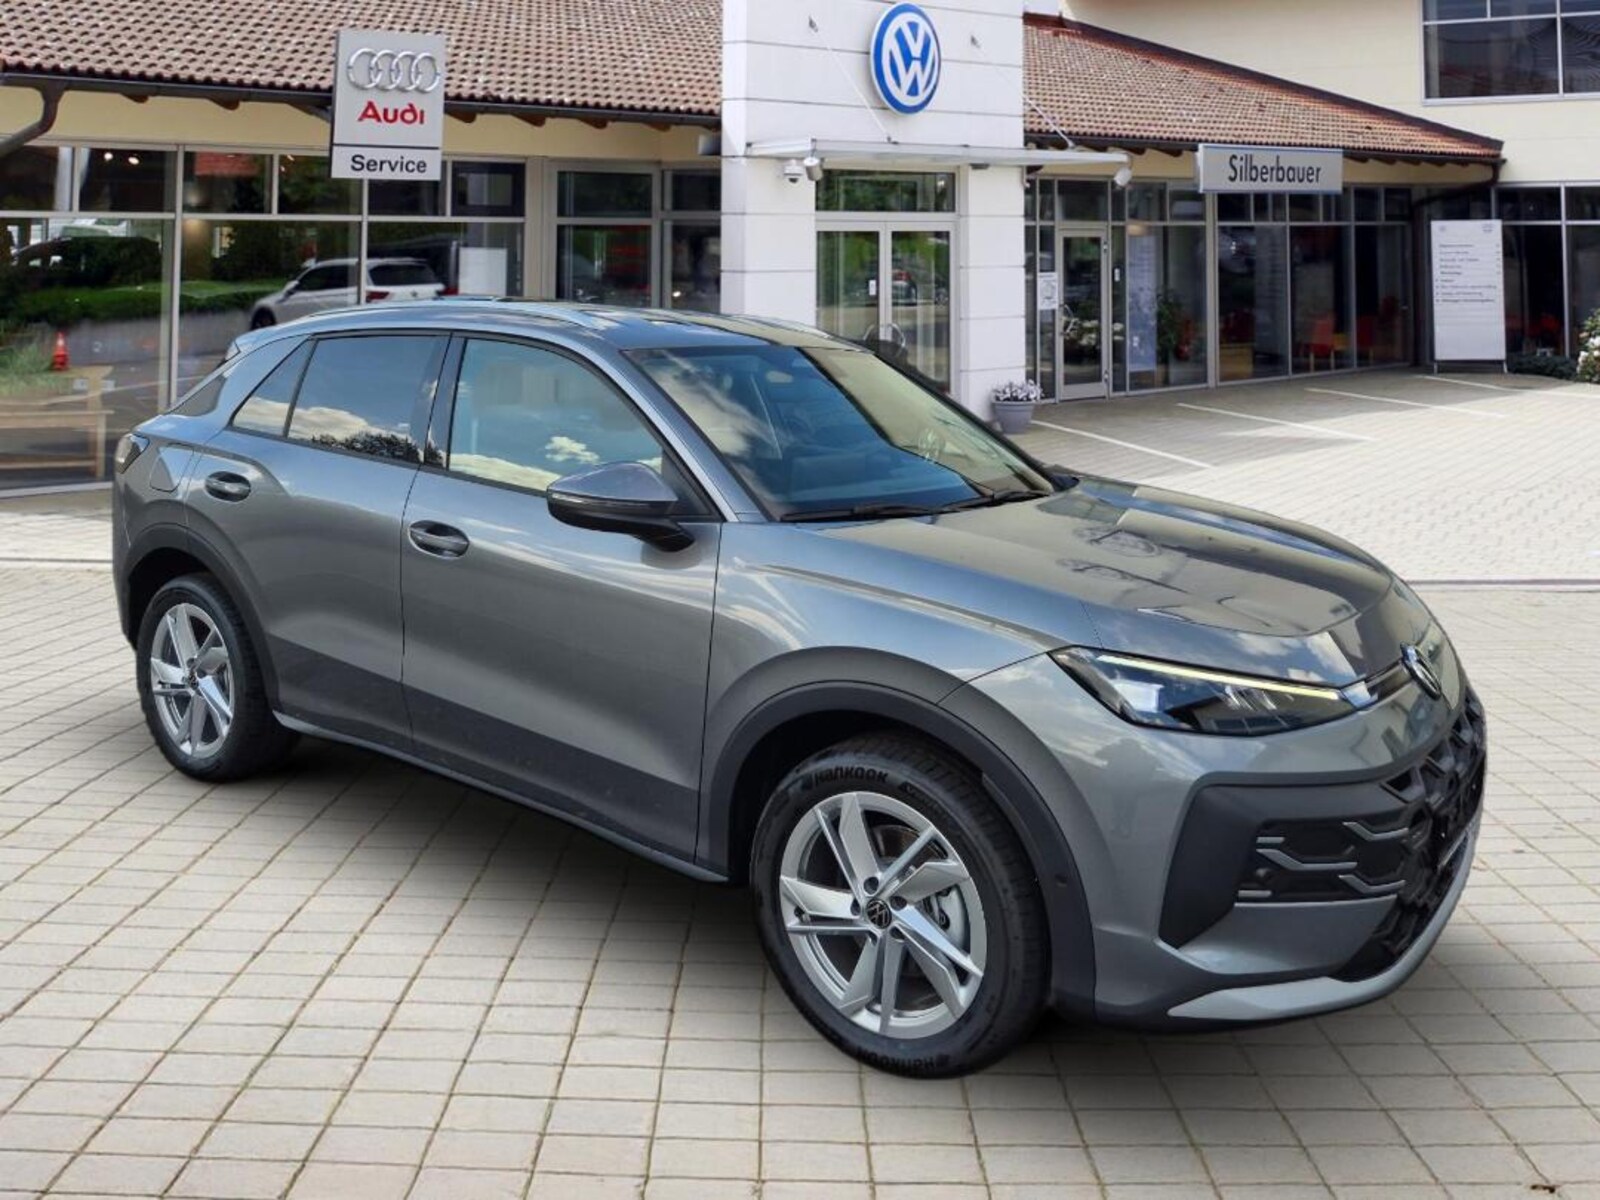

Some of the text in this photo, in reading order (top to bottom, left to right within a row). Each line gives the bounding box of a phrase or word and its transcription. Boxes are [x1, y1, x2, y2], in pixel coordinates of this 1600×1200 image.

[358, 101, 424, 124] Audi
[351, 154, 427, 173] Service
[1228, 154, 1321, 183] Silberbauer
